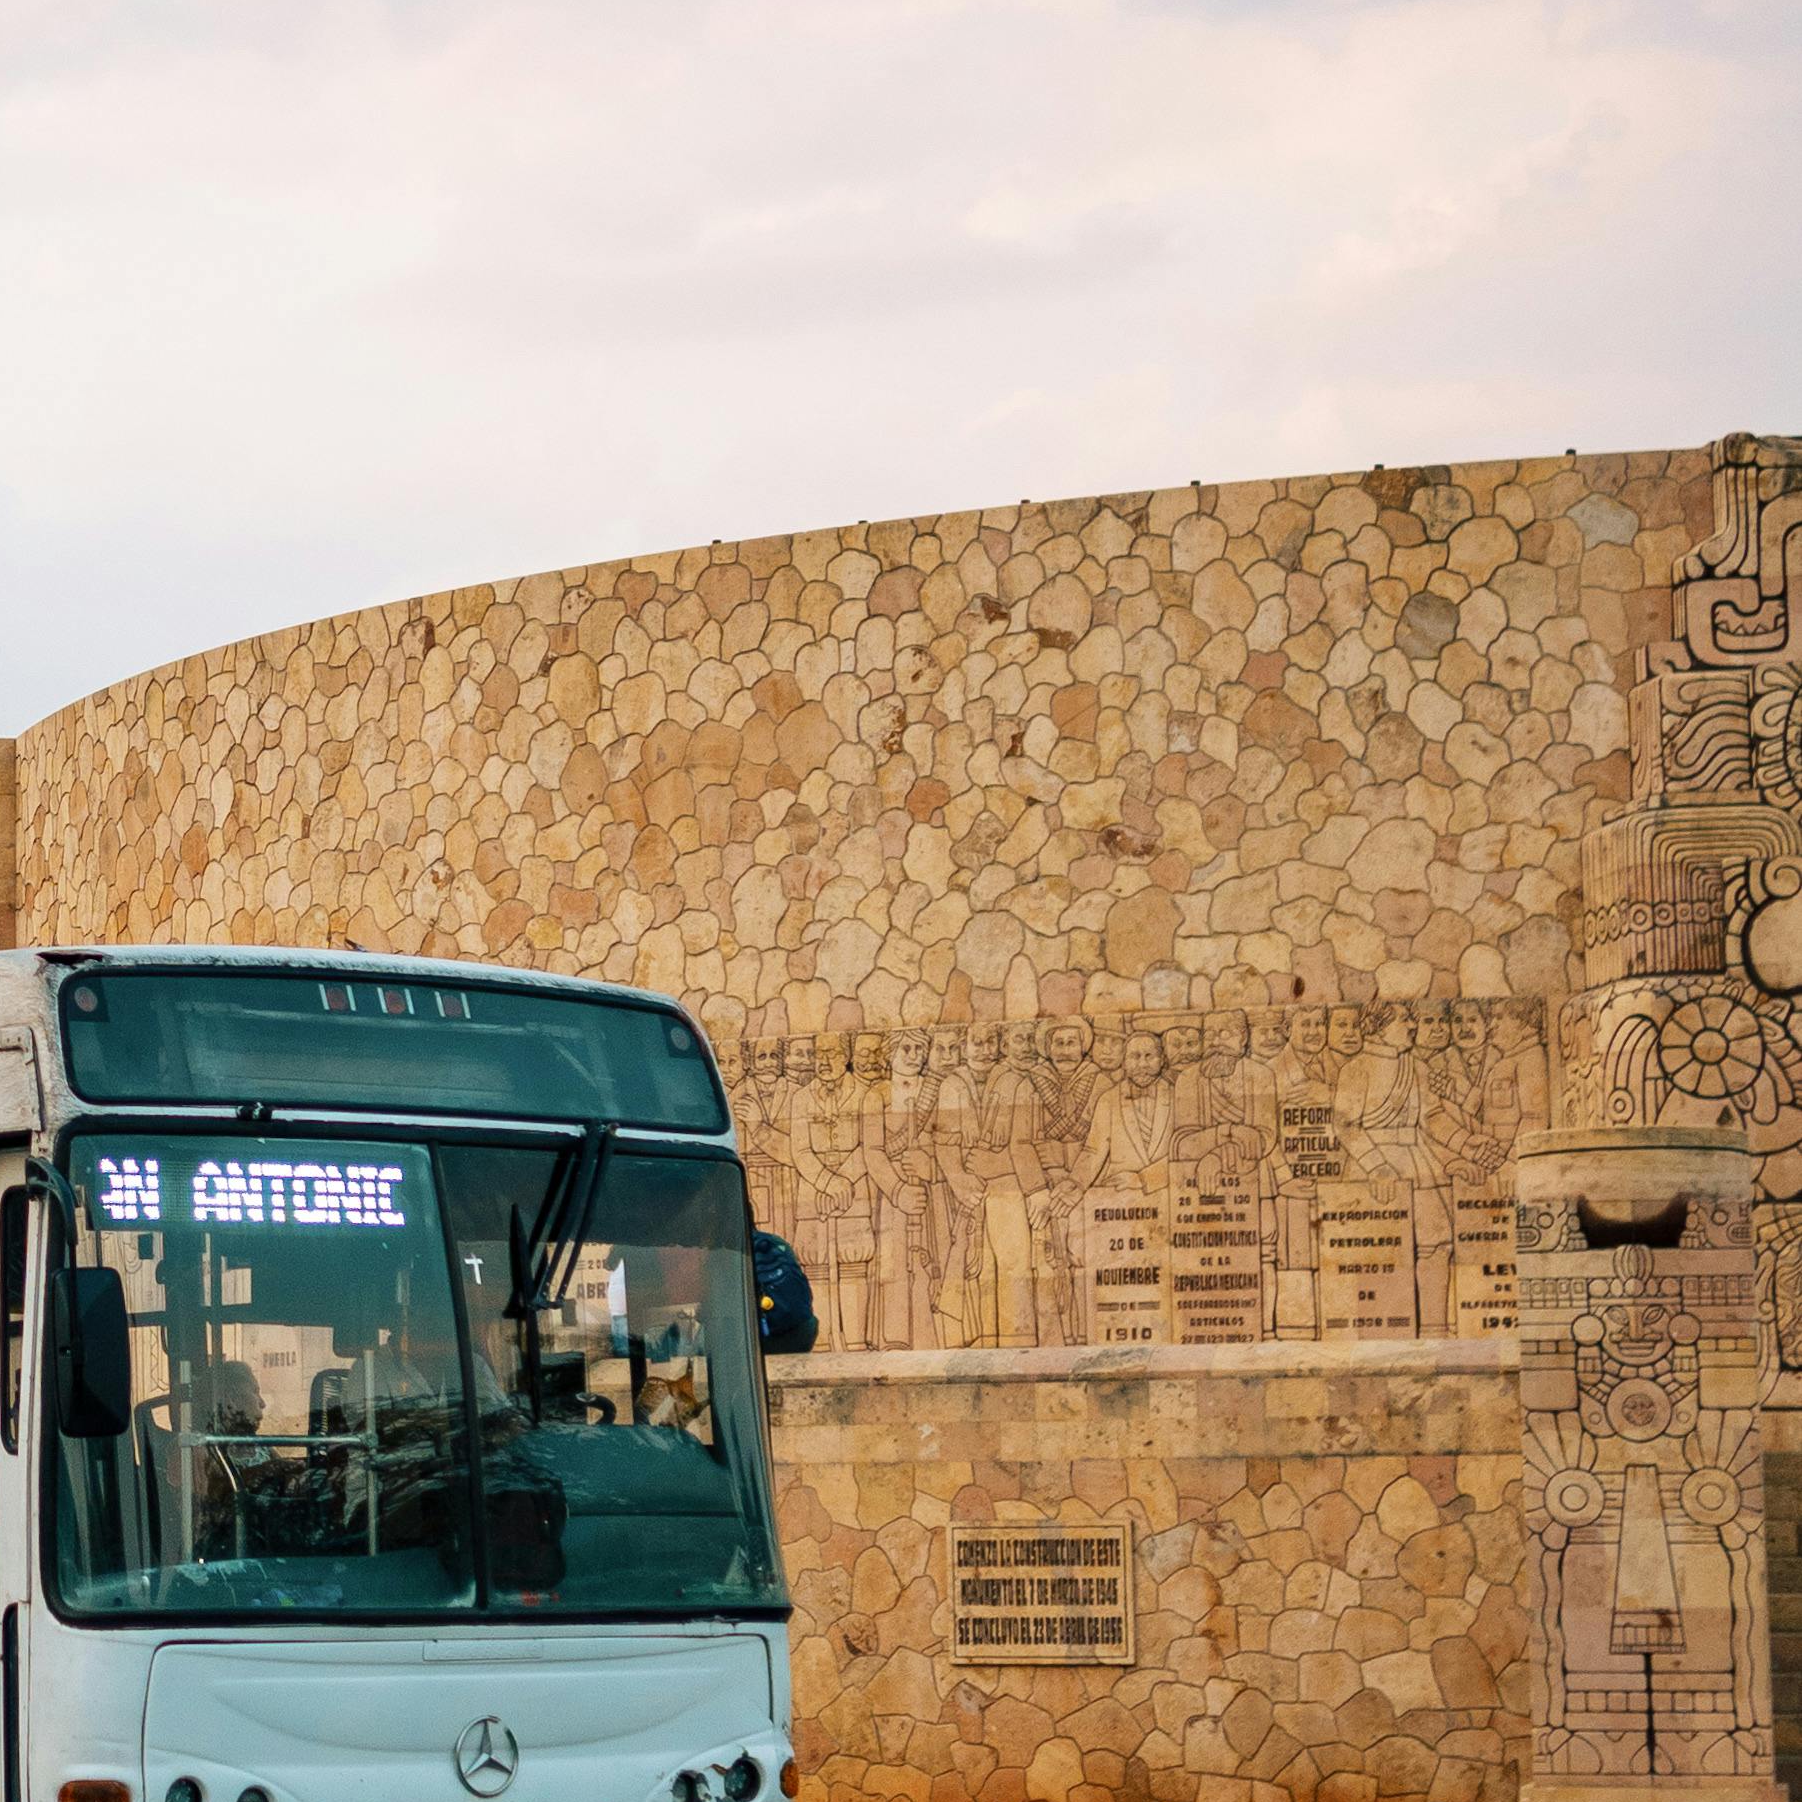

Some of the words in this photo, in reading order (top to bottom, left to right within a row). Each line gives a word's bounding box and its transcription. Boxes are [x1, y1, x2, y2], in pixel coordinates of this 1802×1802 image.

[1109, 1238, 1124, 1251] 20
[1129, 1237, 1144, 1249] DE
[1106, 1327, 1152, 1340] 1910
[1000, 1539, 1013, 1567] LA
[1083, 1538, 1095, 1567] DE
[1097, 1538, 1120, 1566] ESTE
[1015, 1578, 1027, 1606] EL
[1036, 1578, 1048, 1606] DE
[1082, 1578, 1094, 1605] DE
[958, 1617, 970, 1645] SE
[1020, 1616, 1031, 1645] EL
[1046, 1616, 1058, 1644] DE
[1087, 1616, 1099, 1644] DE
